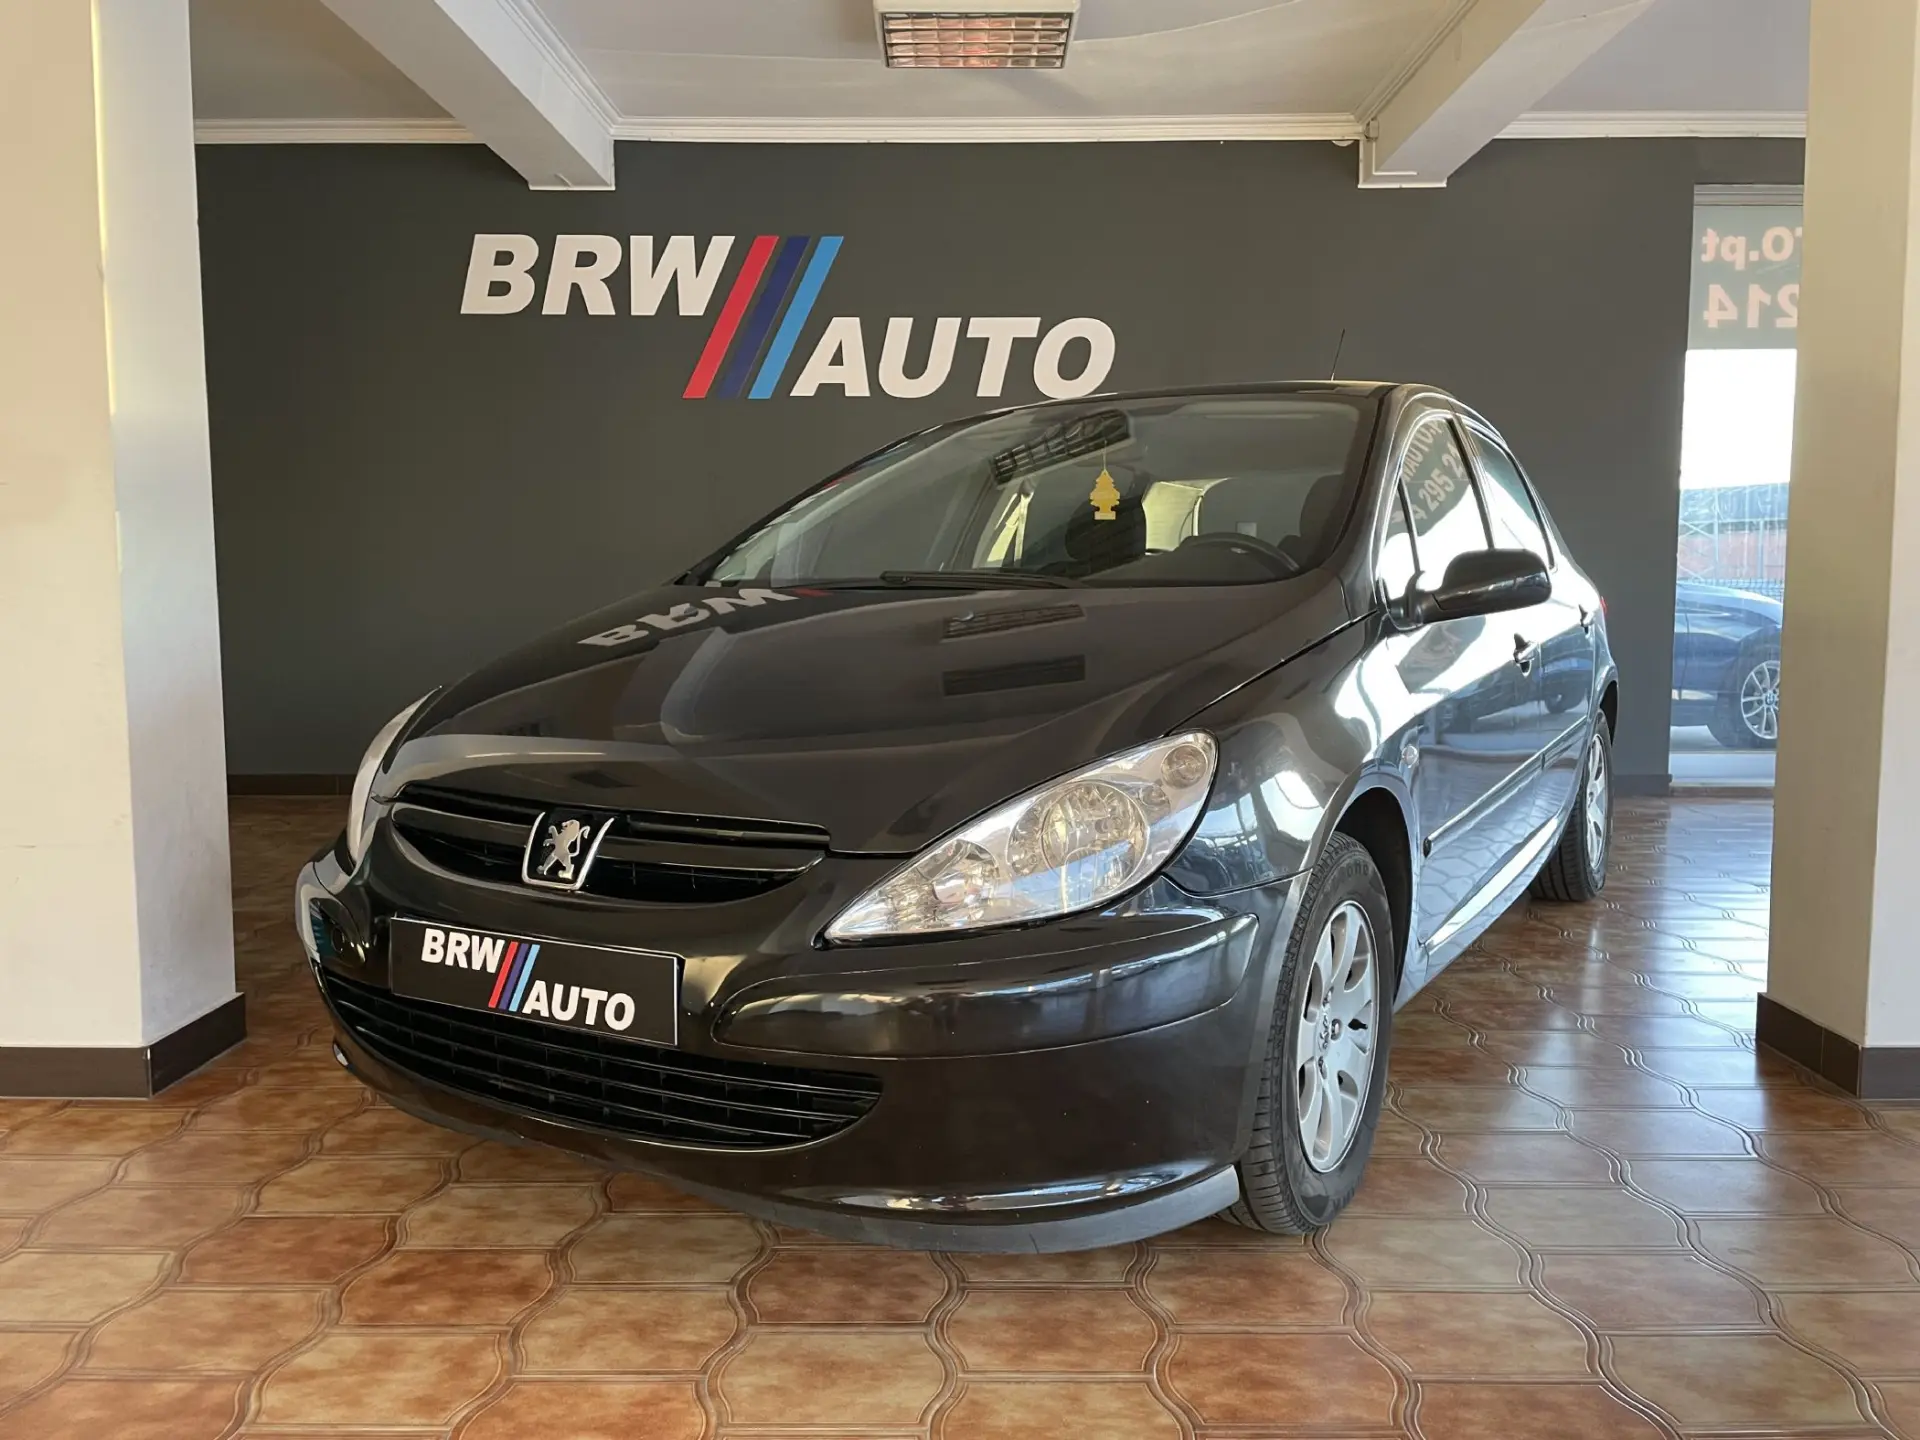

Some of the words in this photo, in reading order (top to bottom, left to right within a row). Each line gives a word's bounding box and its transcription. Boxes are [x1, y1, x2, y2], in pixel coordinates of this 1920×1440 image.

[460, 233, 736, 316] BRW
[789, 316, 1117, 400] AUTO
[421, 928, 505, 973] BRW
[522, 980, 636, 1031] AUTO
